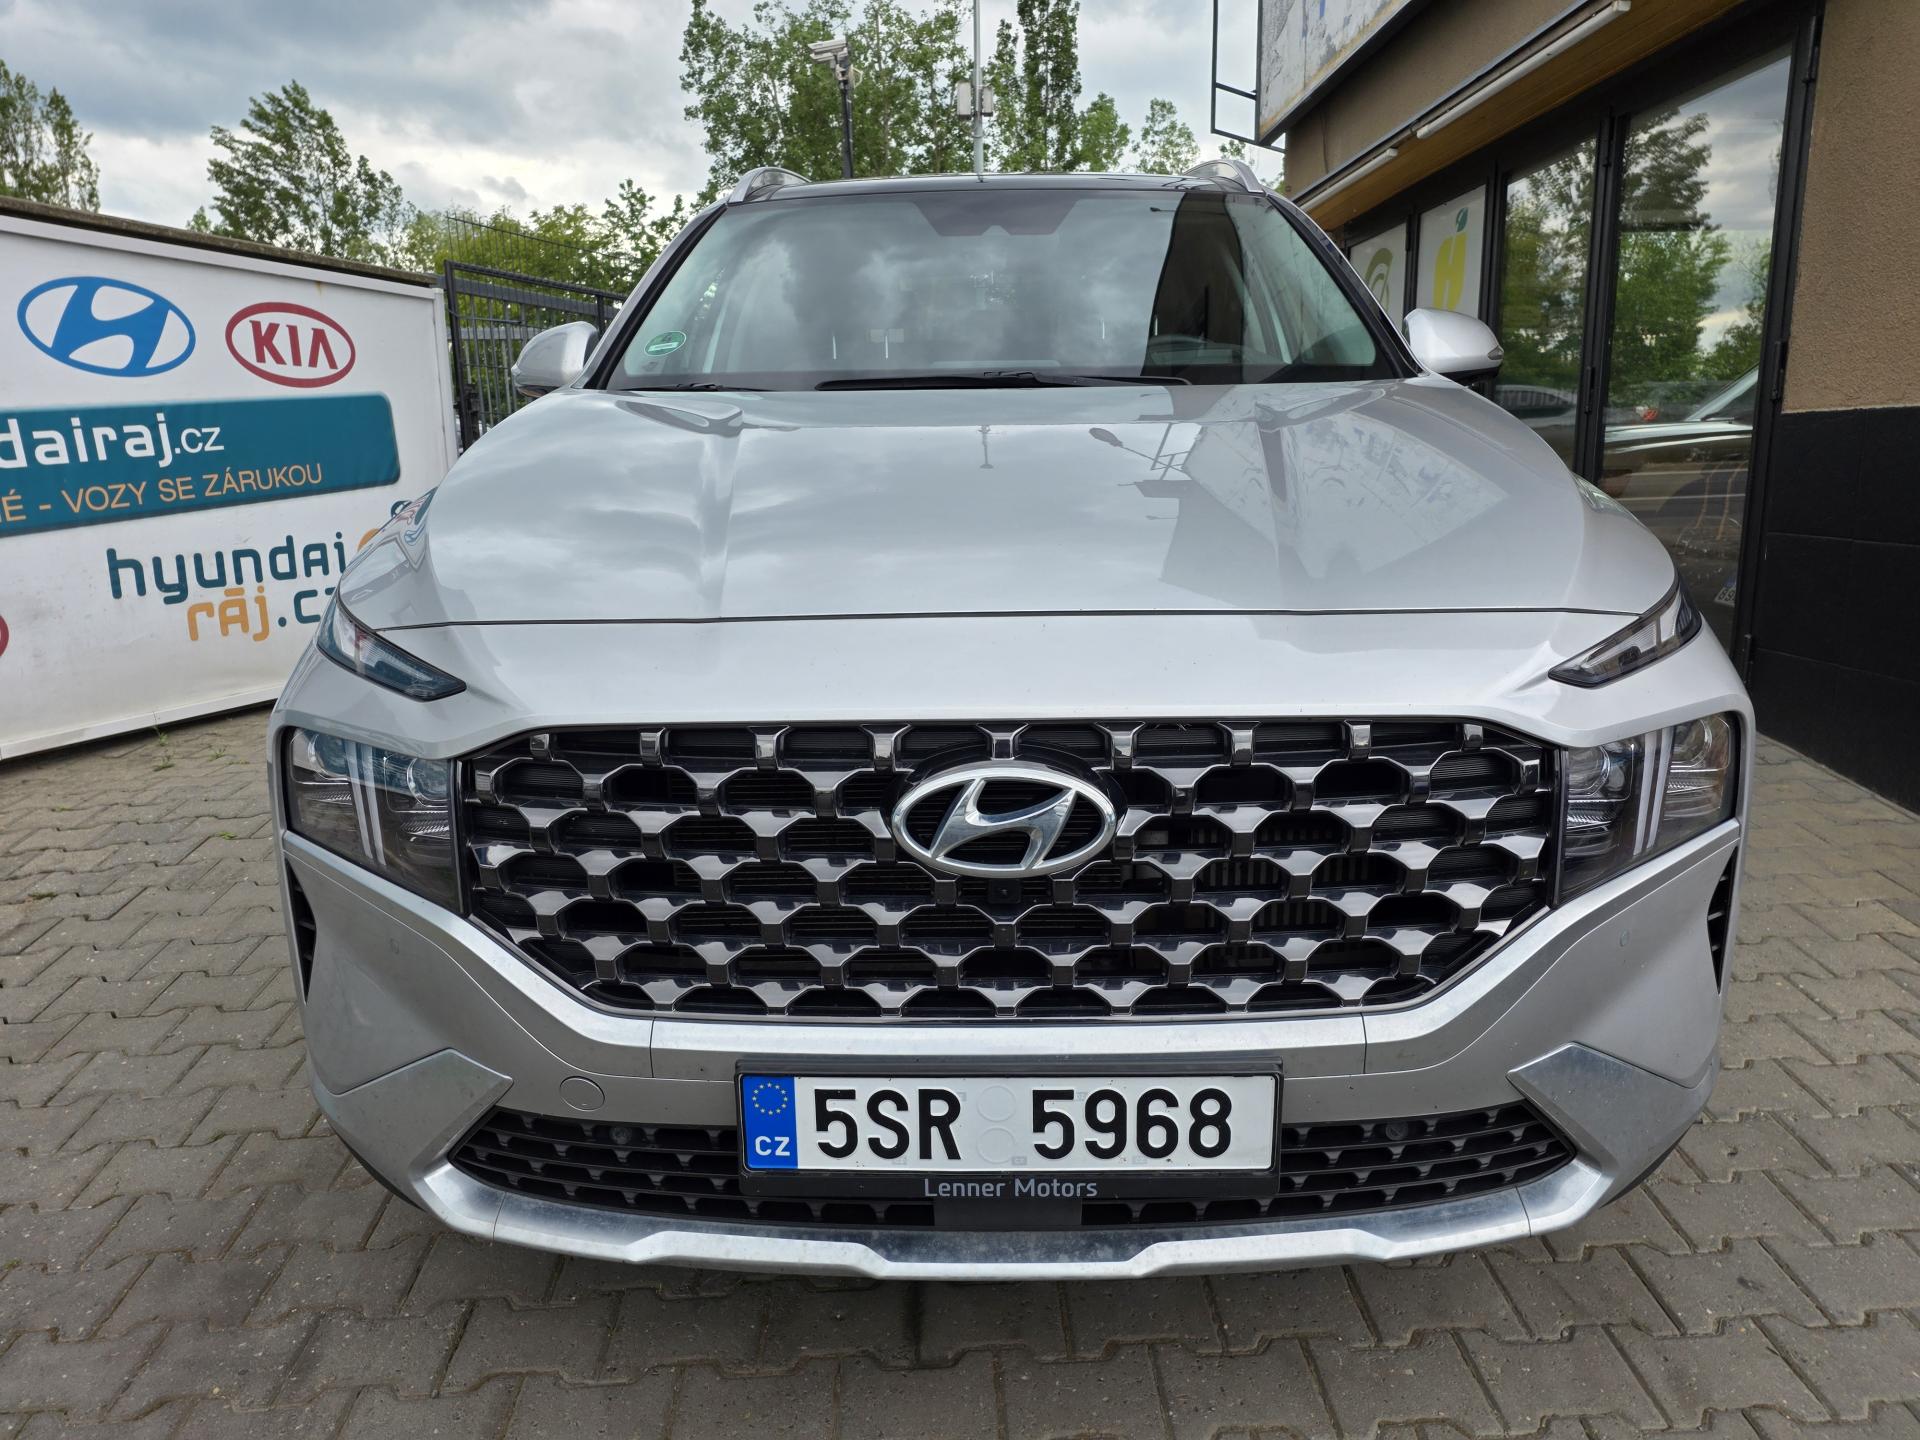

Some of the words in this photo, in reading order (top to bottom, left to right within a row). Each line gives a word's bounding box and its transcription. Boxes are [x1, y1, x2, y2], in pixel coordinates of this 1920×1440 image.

[249, 319, 338, 370] KIA
[61, 481, 147, 514] VOZY
[158, 476, 196, 503] SE
[202, 462, 323, 498] ZÁRUKOU
[754, 1135, 791, 1157] CZ
[813, 1088, 962, 1161] 5SR
[1031, 1087, 1233, 1160] 5968
[923, 1178, 1006, 1198] Lenner
[1013, 1178, 1098, 1198] Motors
